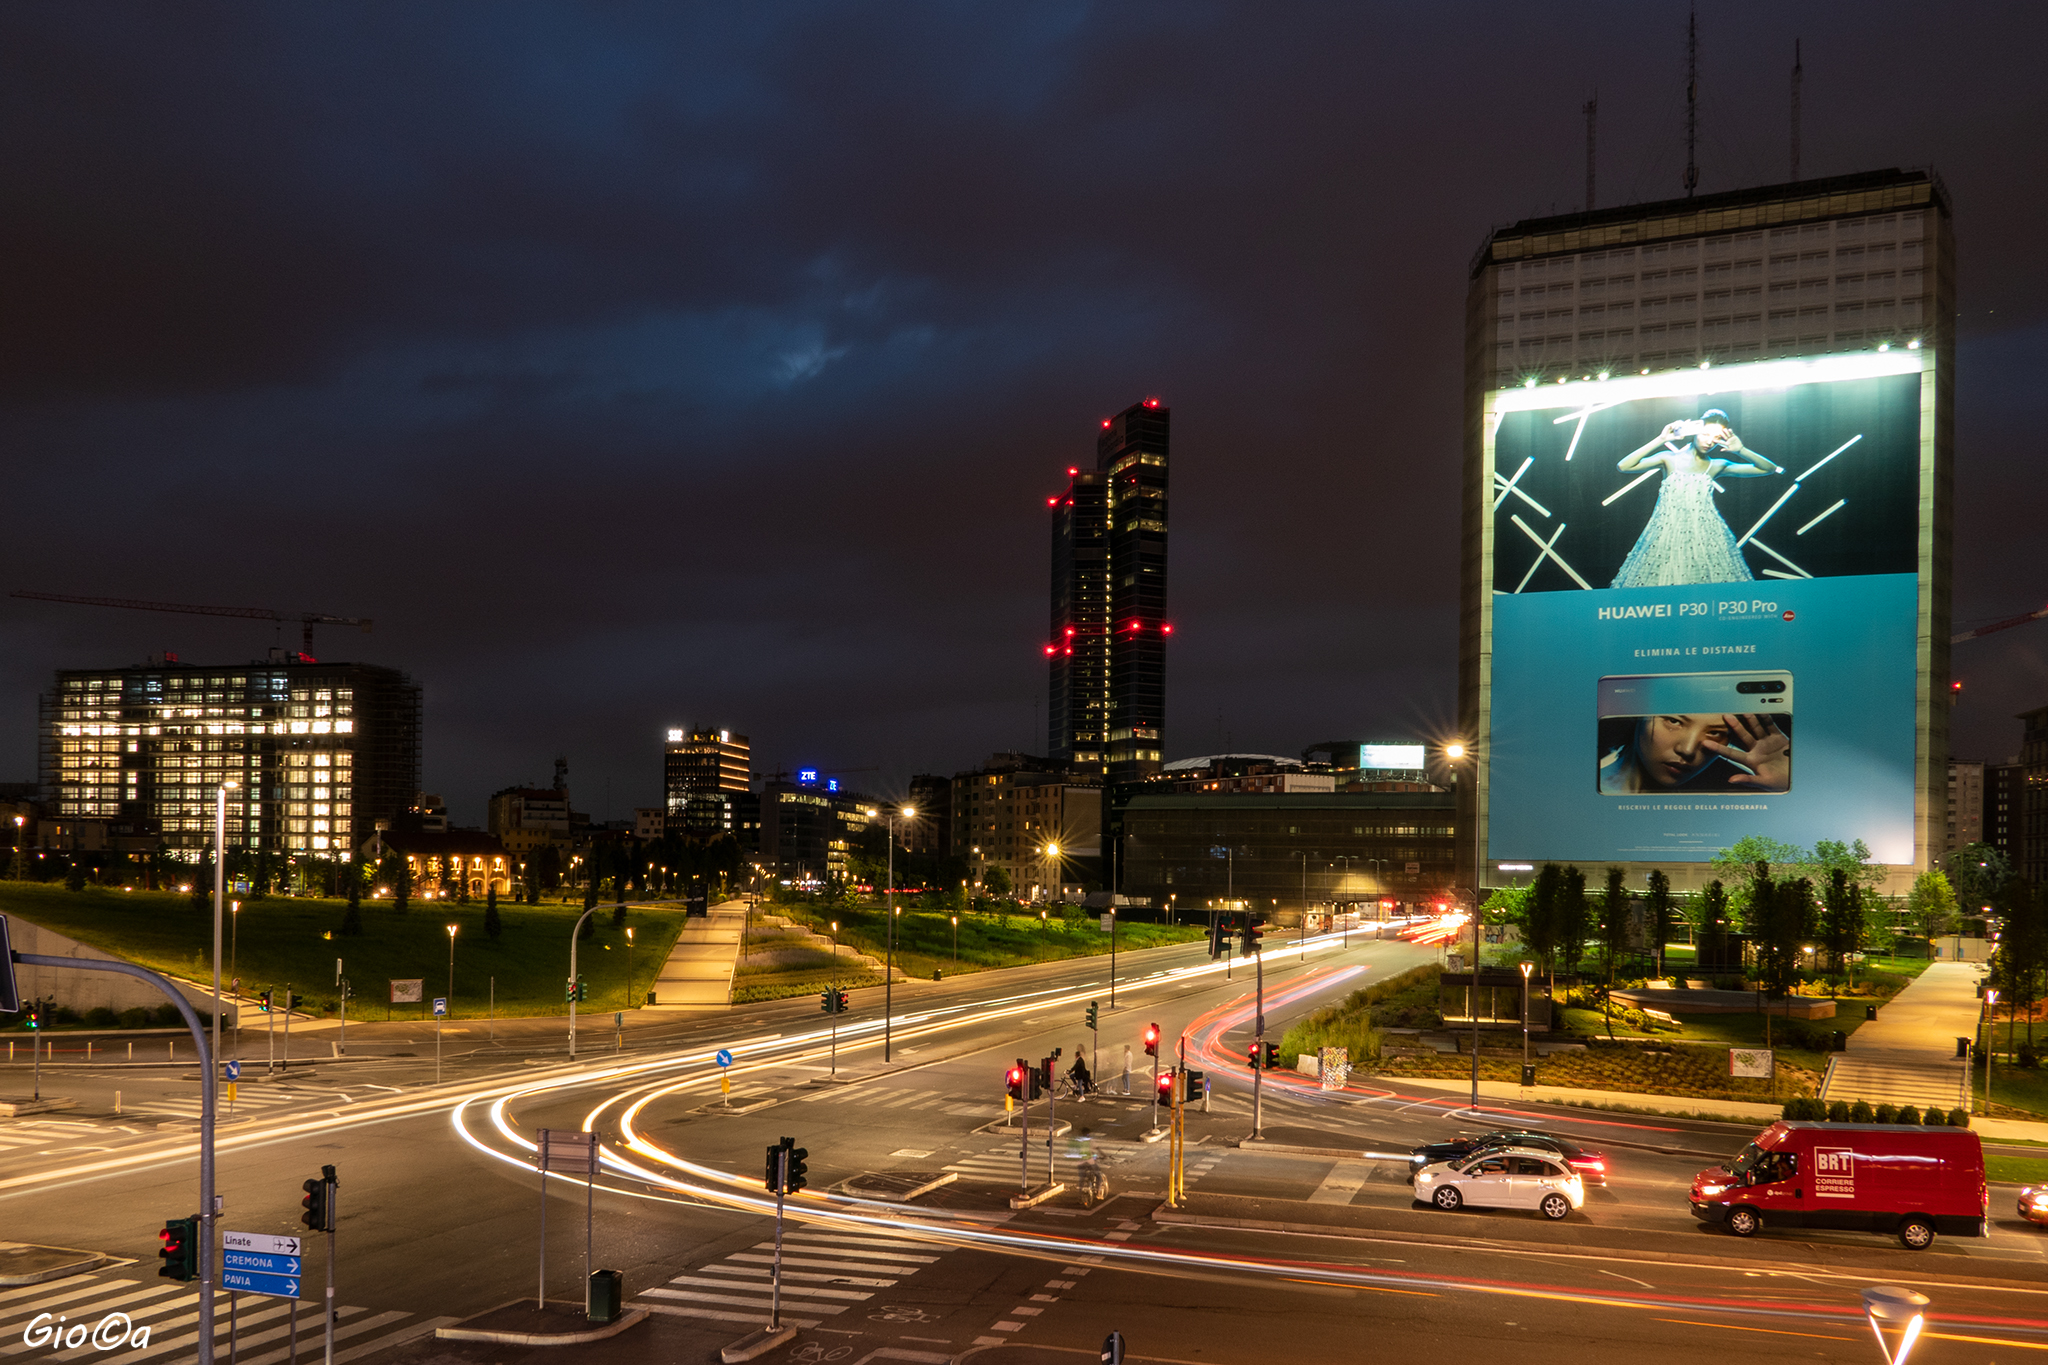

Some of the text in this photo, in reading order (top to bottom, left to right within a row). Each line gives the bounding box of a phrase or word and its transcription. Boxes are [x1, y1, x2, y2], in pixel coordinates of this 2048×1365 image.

[1598, 599, 1778, 620] HUAWEI P30 P30 Pro
[1634, 644, 1757, 658] ELIMINA LE DISTANZE
[801, 770, 816, 781] ZTE
[1818, 1153, 1850, 1171] BRT
[1815, 1178, 1855, 1186] CORRIERE
[1815, 1185, 1855, 1193] ESPRESSO
[225, 1235, 251, 1248] Linate
[225, 1254, 273, 1269] CREMONA
[224, 1274, 251, 1287] PAVIA
